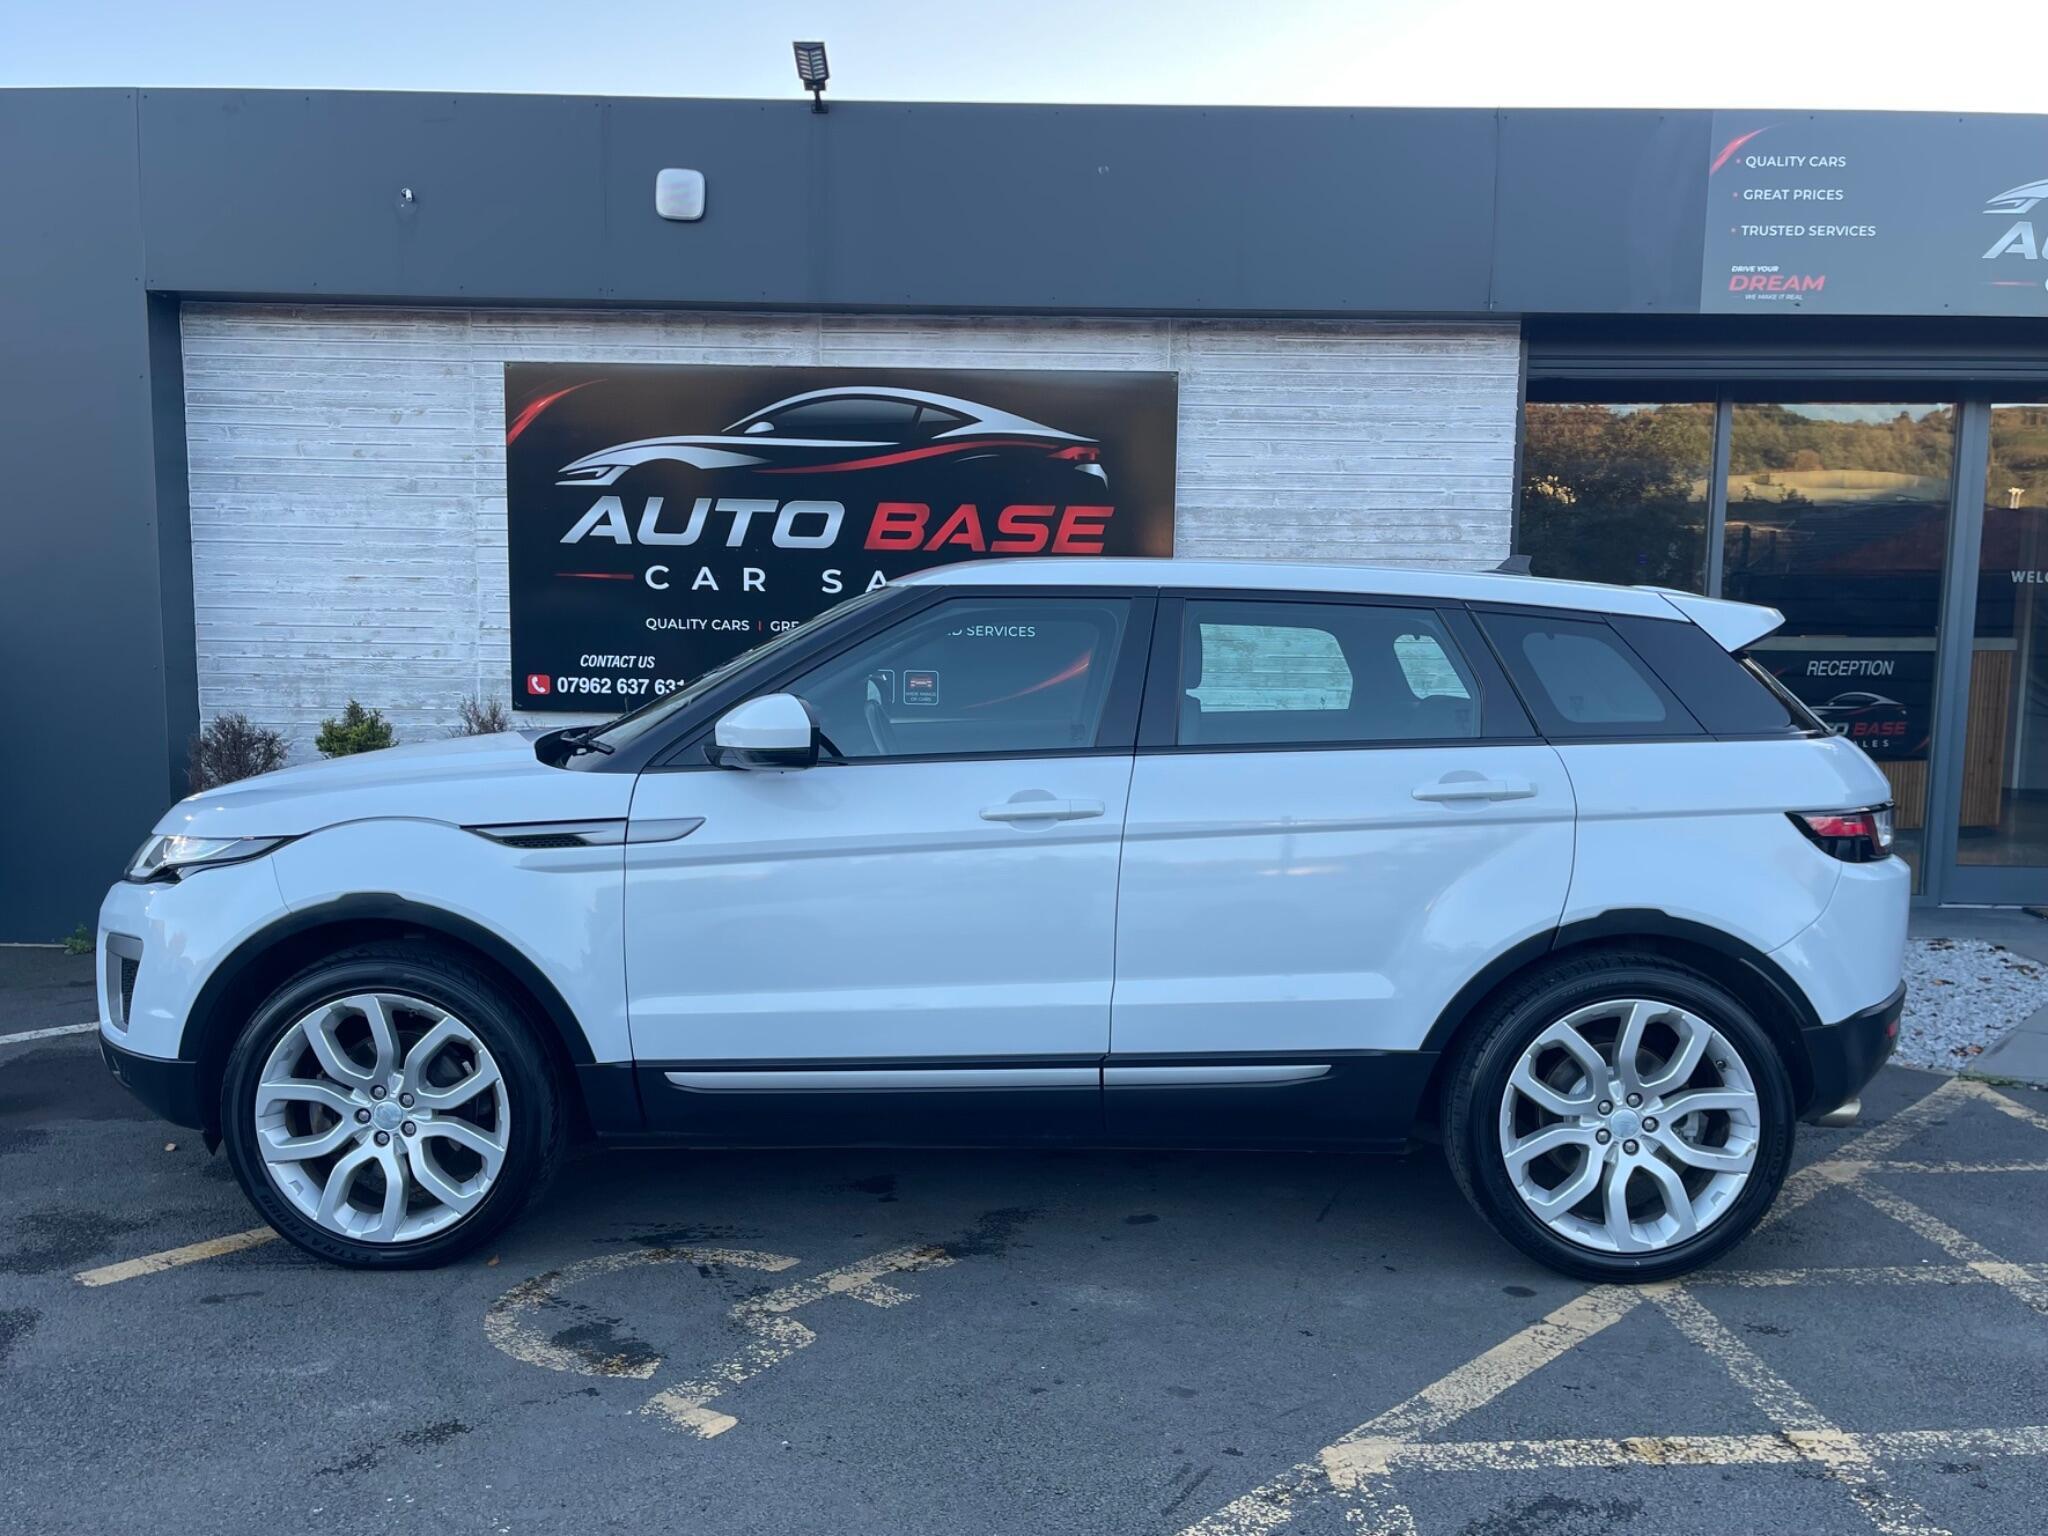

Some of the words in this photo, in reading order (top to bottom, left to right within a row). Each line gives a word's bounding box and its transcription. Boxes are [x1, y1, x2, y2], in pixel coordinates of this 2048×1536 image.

[1745, 156, 1806, 169] QUALITY
[1809, 156, 1846, 168] CARS
[1743, 189, 1790, 200] GREAT
[1794, 189, 1844, 200] PRICES
[1742, 225, 1805, 236] TRUSTED
[1809, 225, 1876, 236] SERVICES
[1729, 275, 1825, 290] DREAM
[559, 495, 845, 549] AUTO
[864, 502, 1114, 553] BASE
[645, 565, 766, 592] CAR
[822, 569, 886, 594] SA
[646, 618, 707, 630] QUALITY
[711, 619, 750, 631] CARS
[967, 626, 1035, 637] SERVICES
[580, 654, 631, 669] CONTACT
[634, 655, 655, 669] US
[1807, 660, 1894, 676] RECEPTION
[557, 675, 611, 695] 07962
[616, 677, 649, 695] 637
[654, 678, 685, 695] 63
[1853, 721, 1907, 736] BASE
